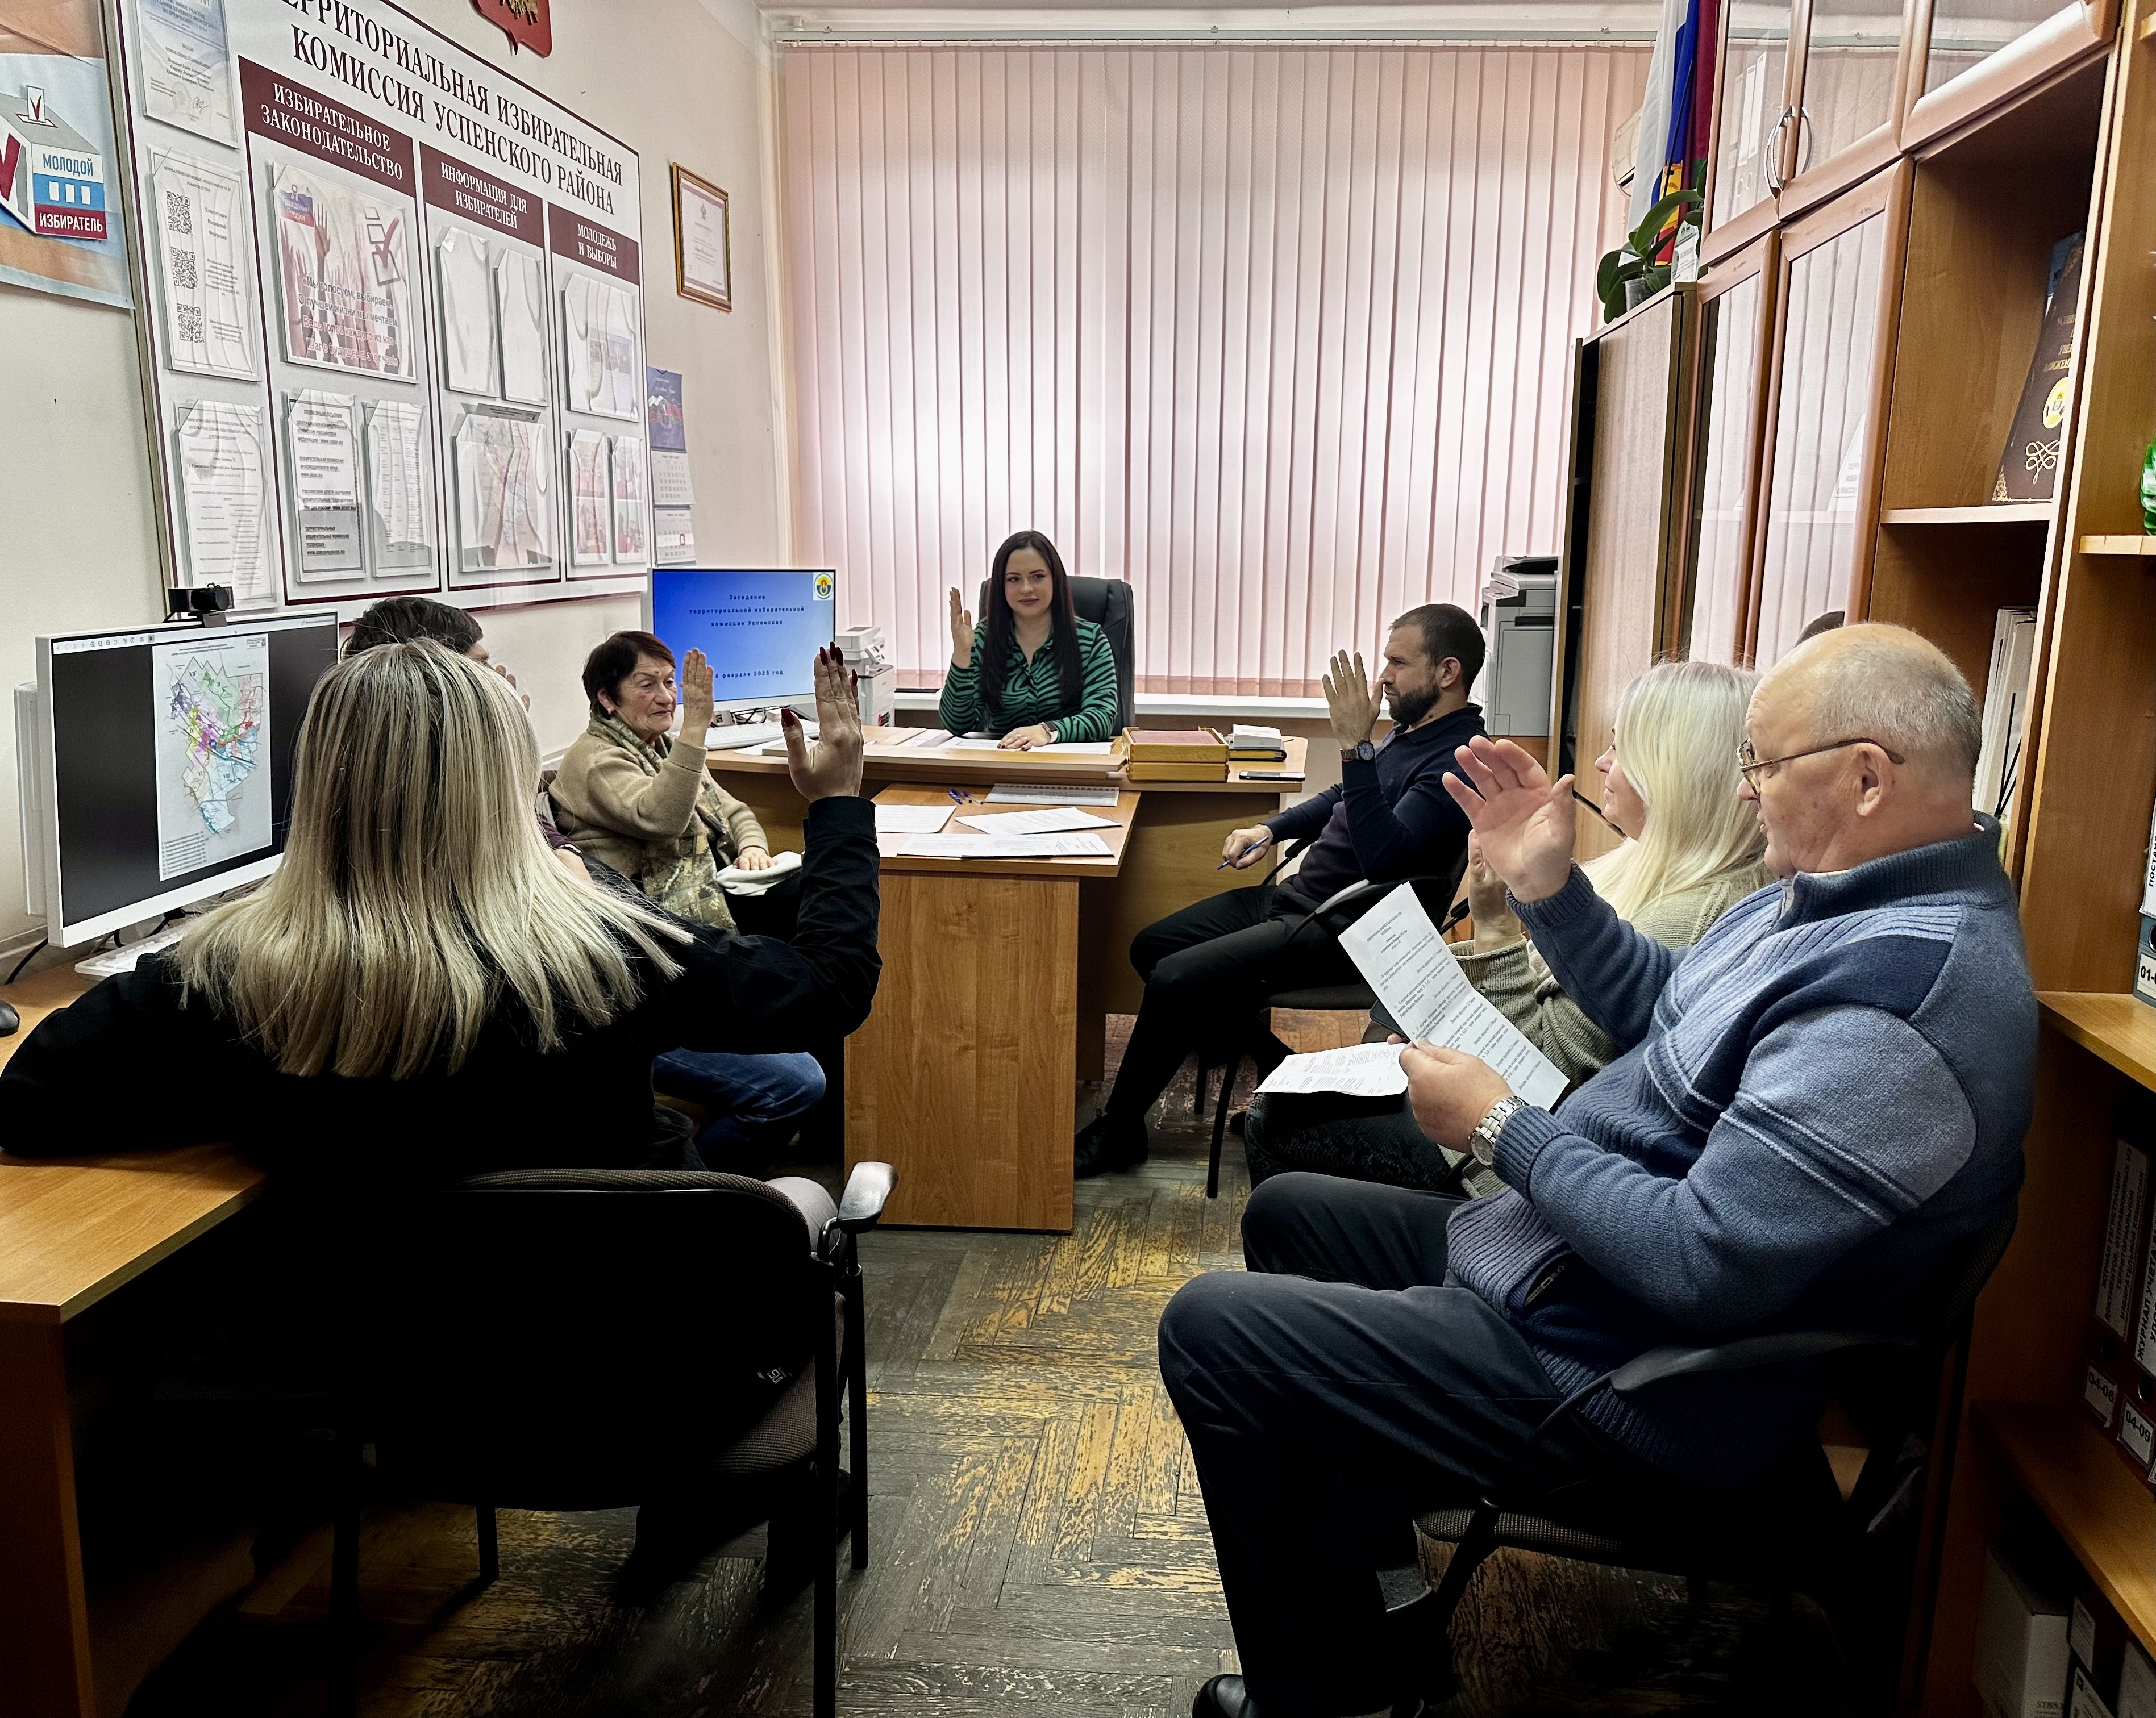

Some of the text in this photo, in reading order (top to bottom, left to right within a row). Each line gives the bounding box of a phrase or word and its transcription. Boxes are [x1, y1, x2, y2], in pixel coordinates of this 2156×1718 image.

[282, 0, 490, 116] РИТОРИАЛЬНАЯ
[496, 94, 623, 186] ИЗБИРАТЕЛЬНАЯ
[272, 82, 391, 152] ИЗБИРАТЕЛЬНОЕ
[290, 24, 426, 123] КОМИССИЯ
[432, 100, 552, 184] УСПЕНСКОГО
[556, 164, 615, 216] РАЙОНА
[260, 103, 403, 181] ЗАКОНОДАТЕЛЬСТВО
[43, 153, 94, 177] МОЛОДОЙ
[440, 162, 528, 214] ИНФОРМАЦИЯ ДЛЯ
[39, 212, 103, 232] ИЗБИРАТЕЛЬ
[455, 189, 518, 230] ИЗБИРАТЕЛЕЙ
[577, 223, 617, 251] МОЛОДЕЖЬ
[578, 241, 617, 269] И ВЫБОРЫ
[2141, 965, 2156, 985] 01-
[2138, 1298, 2151, 1361] ЖУРНАЛ
[2088, 1371, 2114, 1403] 04-06
[2125, 1410, 2150, 1442] 04-09
